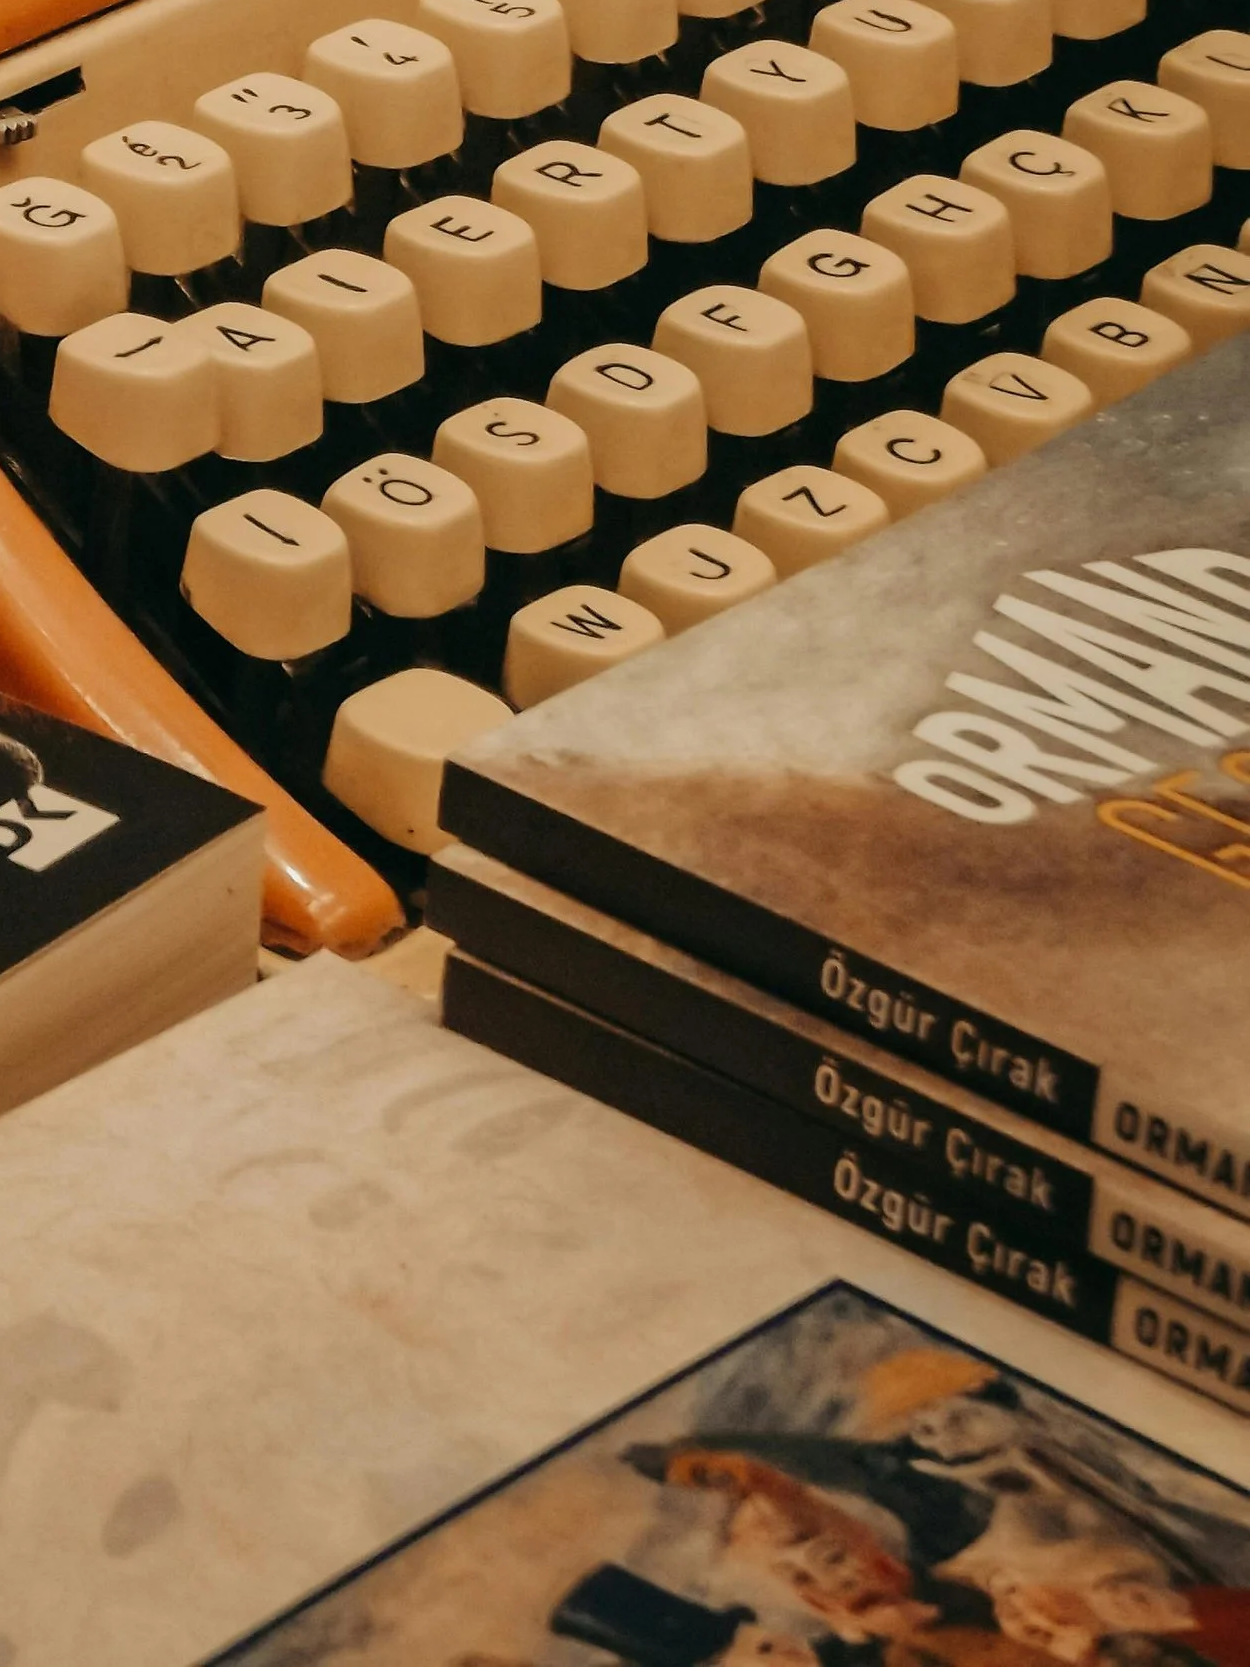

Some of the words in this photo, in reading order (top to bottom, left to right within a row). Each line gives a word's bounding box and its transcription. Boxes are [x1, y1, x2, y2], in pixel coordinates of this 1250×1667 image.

[820, 949, 936, 1040] Özgür
[950, 1019, 1061, 1103] Çırak
[814, 1056, 932, 1148] Özgür
[944, 1127, 1055, 1212] Çırak
[833, 1151, 953, 1244] Özgür
[966, 1222, 1079, 1308] Çırak
